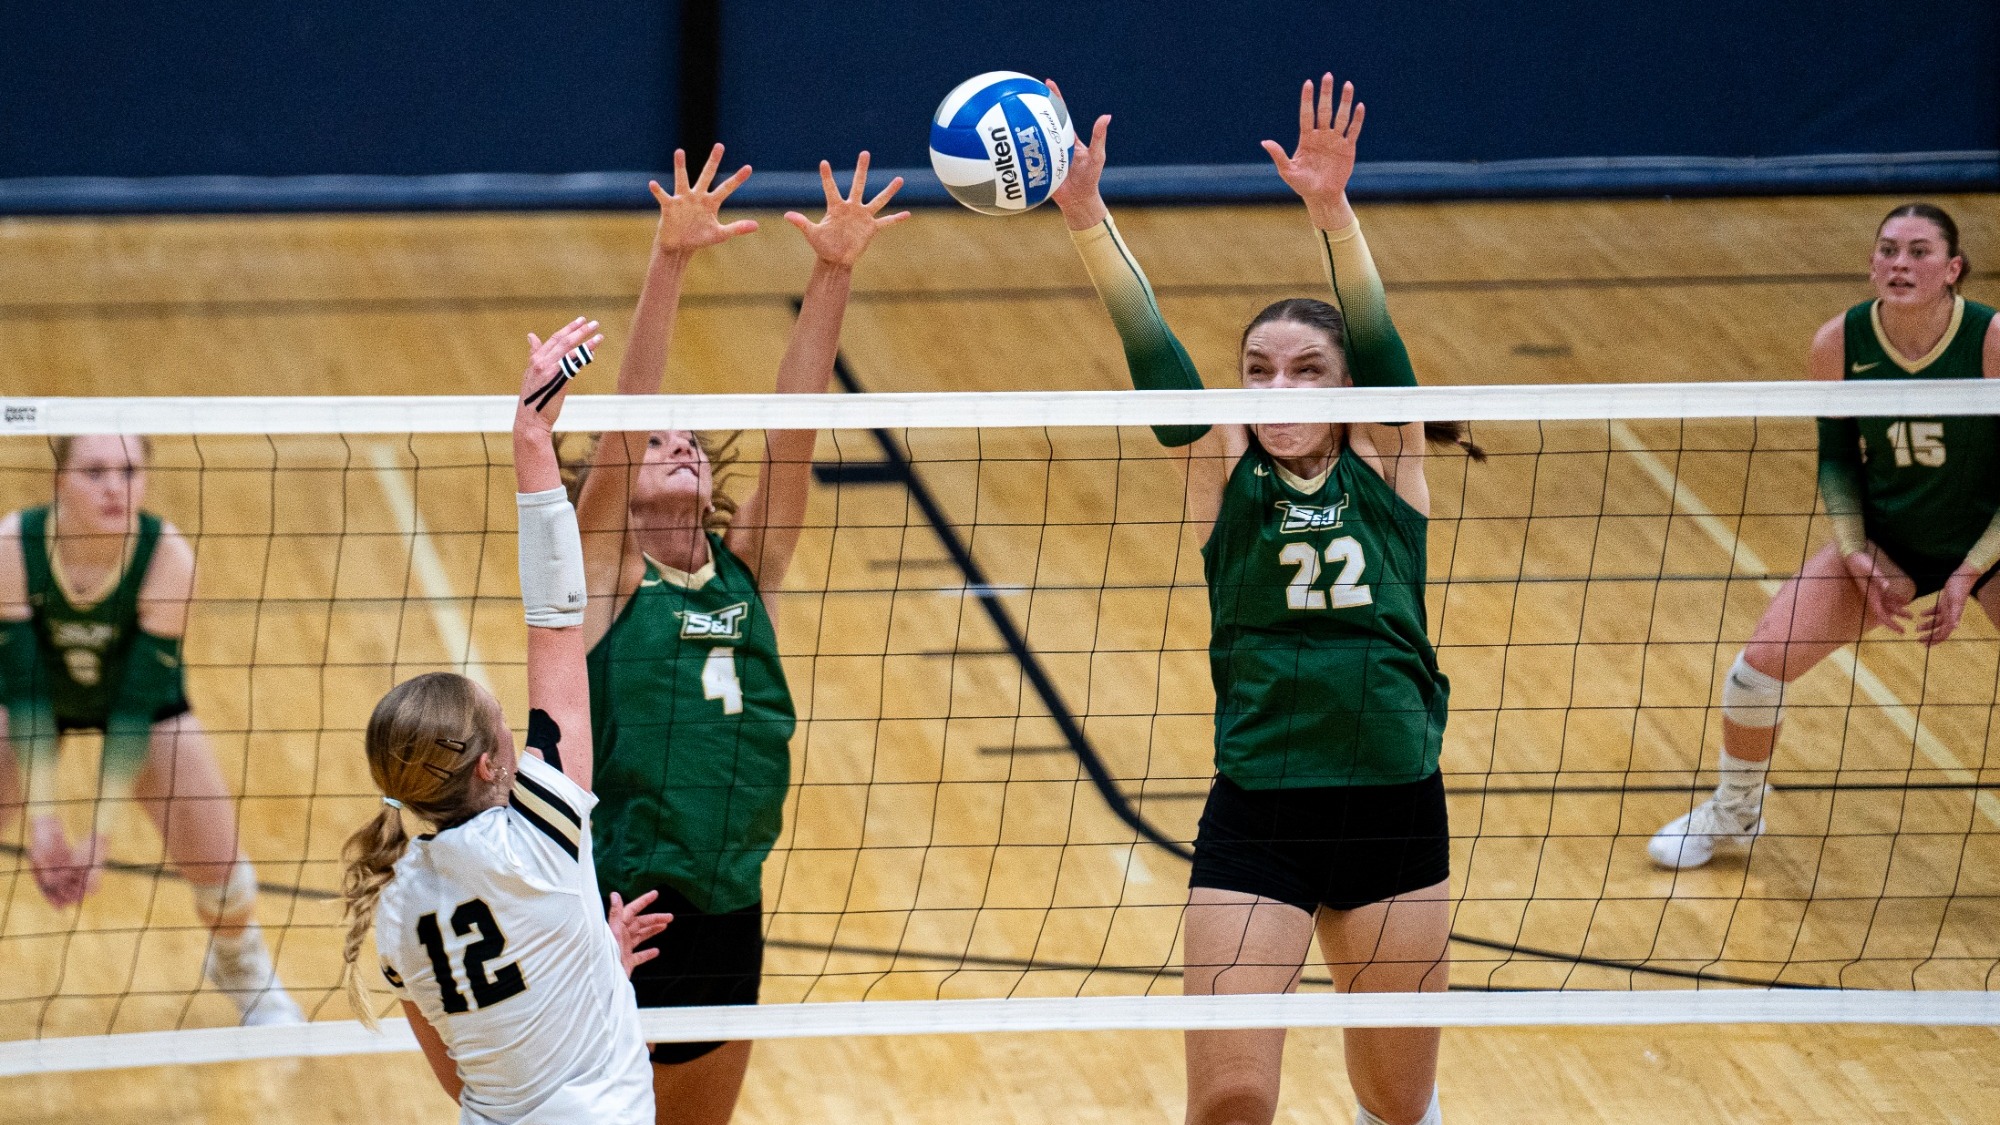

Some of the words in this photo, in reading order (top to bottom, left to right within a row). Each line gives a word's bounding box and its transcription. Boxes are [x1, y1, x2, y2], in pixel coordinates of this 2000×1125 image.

[991, 126, 1022, 200] molten
[1017, 125, 1046, 188] NCAA
[1886, 420, 1946, 468] 15
[1279, 535, 1373, 610] 22
[680, 603, 747, 638] S&T
[701, 646, 744, 715] 4
[416, 896, 528, 1015] 12
